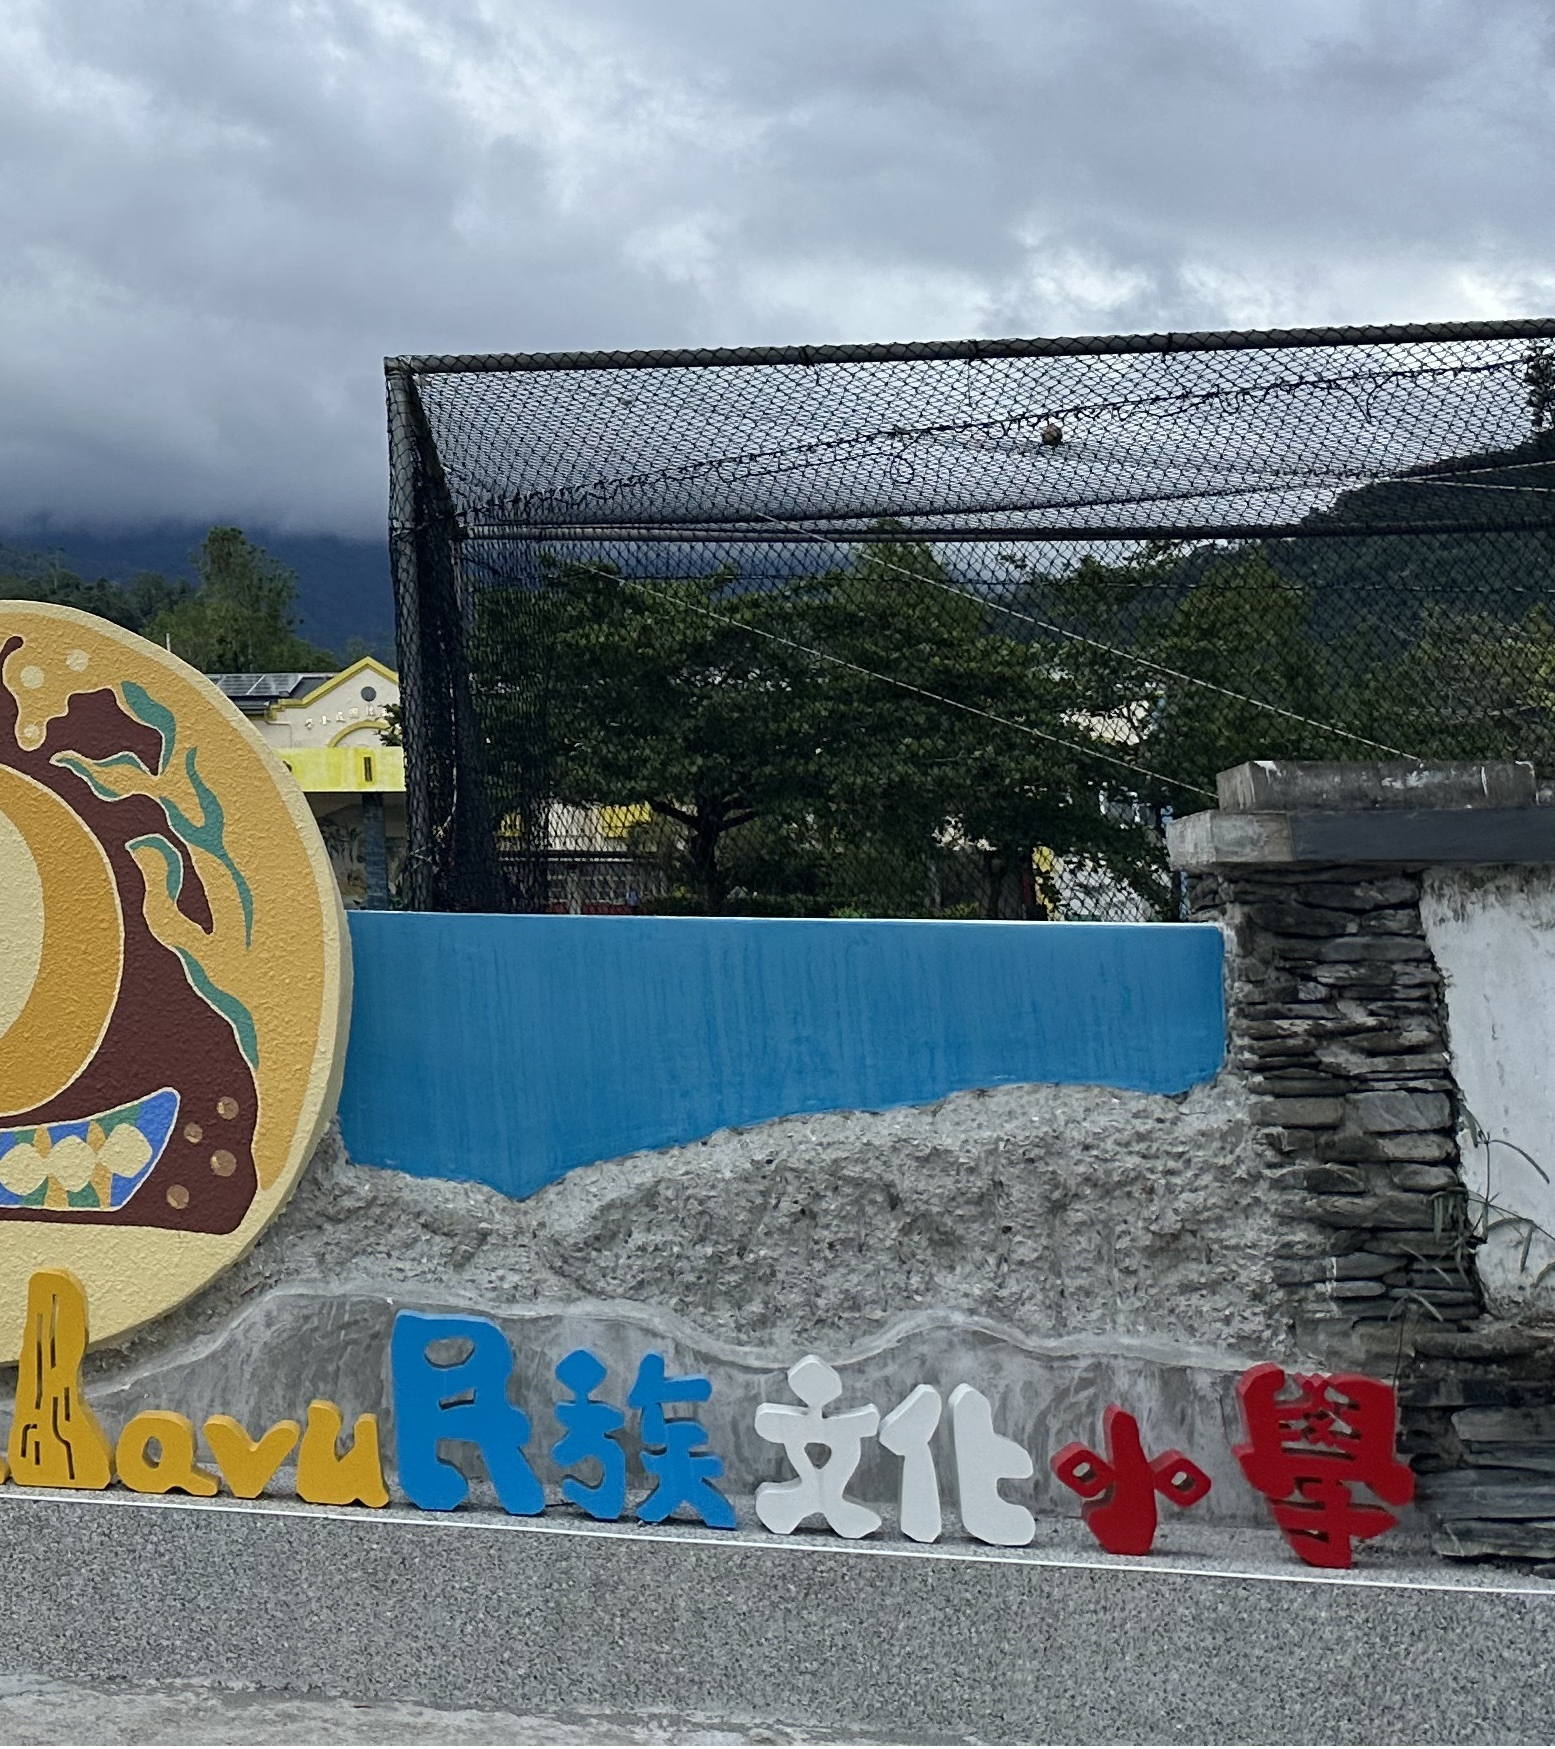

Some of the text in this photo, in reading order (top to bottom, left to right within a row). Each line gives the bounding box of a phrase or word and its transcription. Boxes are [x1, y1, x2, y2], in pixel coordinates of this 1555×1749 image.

[390, 1309, 1415, 1569] 民族文化小學
